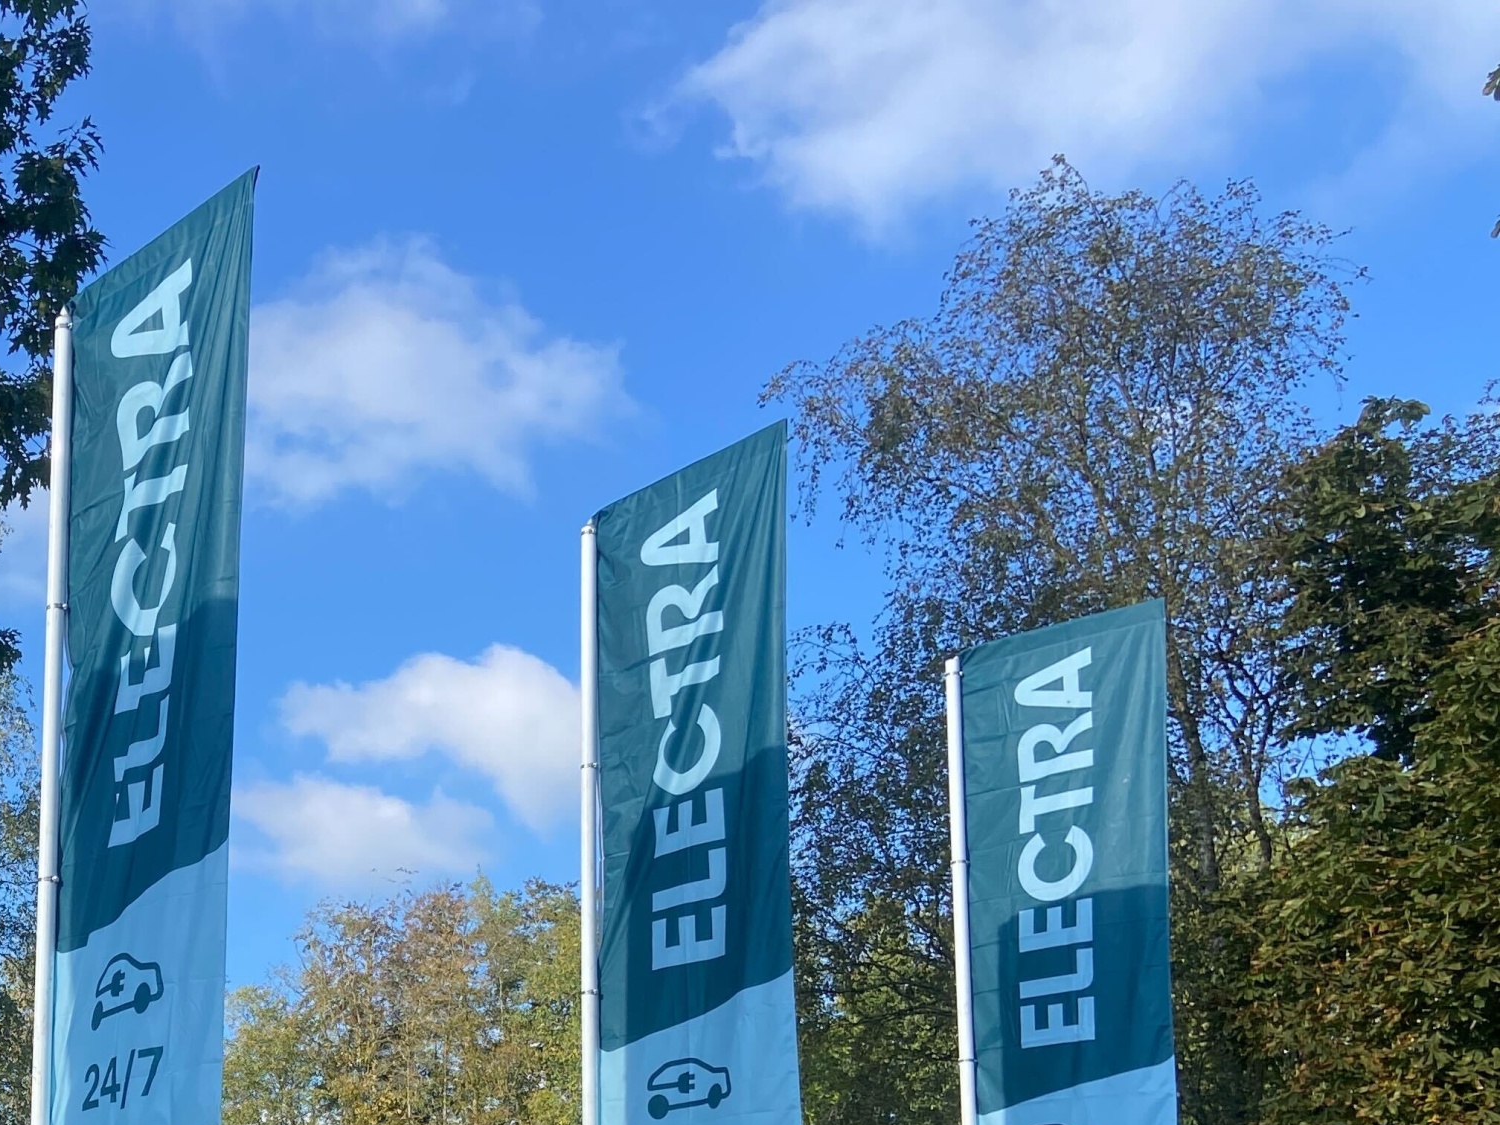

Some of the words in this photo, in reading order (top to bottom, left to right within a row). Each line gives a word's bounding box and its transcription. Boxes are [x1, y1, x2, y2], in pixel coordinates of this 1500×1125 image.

[107, 257, 193, 849] ELECTRA
[640, 488, 727, 971] ELECTRA
[1014, 646, 1096, 1050] ELECTRA
[82, 1045, 164, 1112] 24/7
